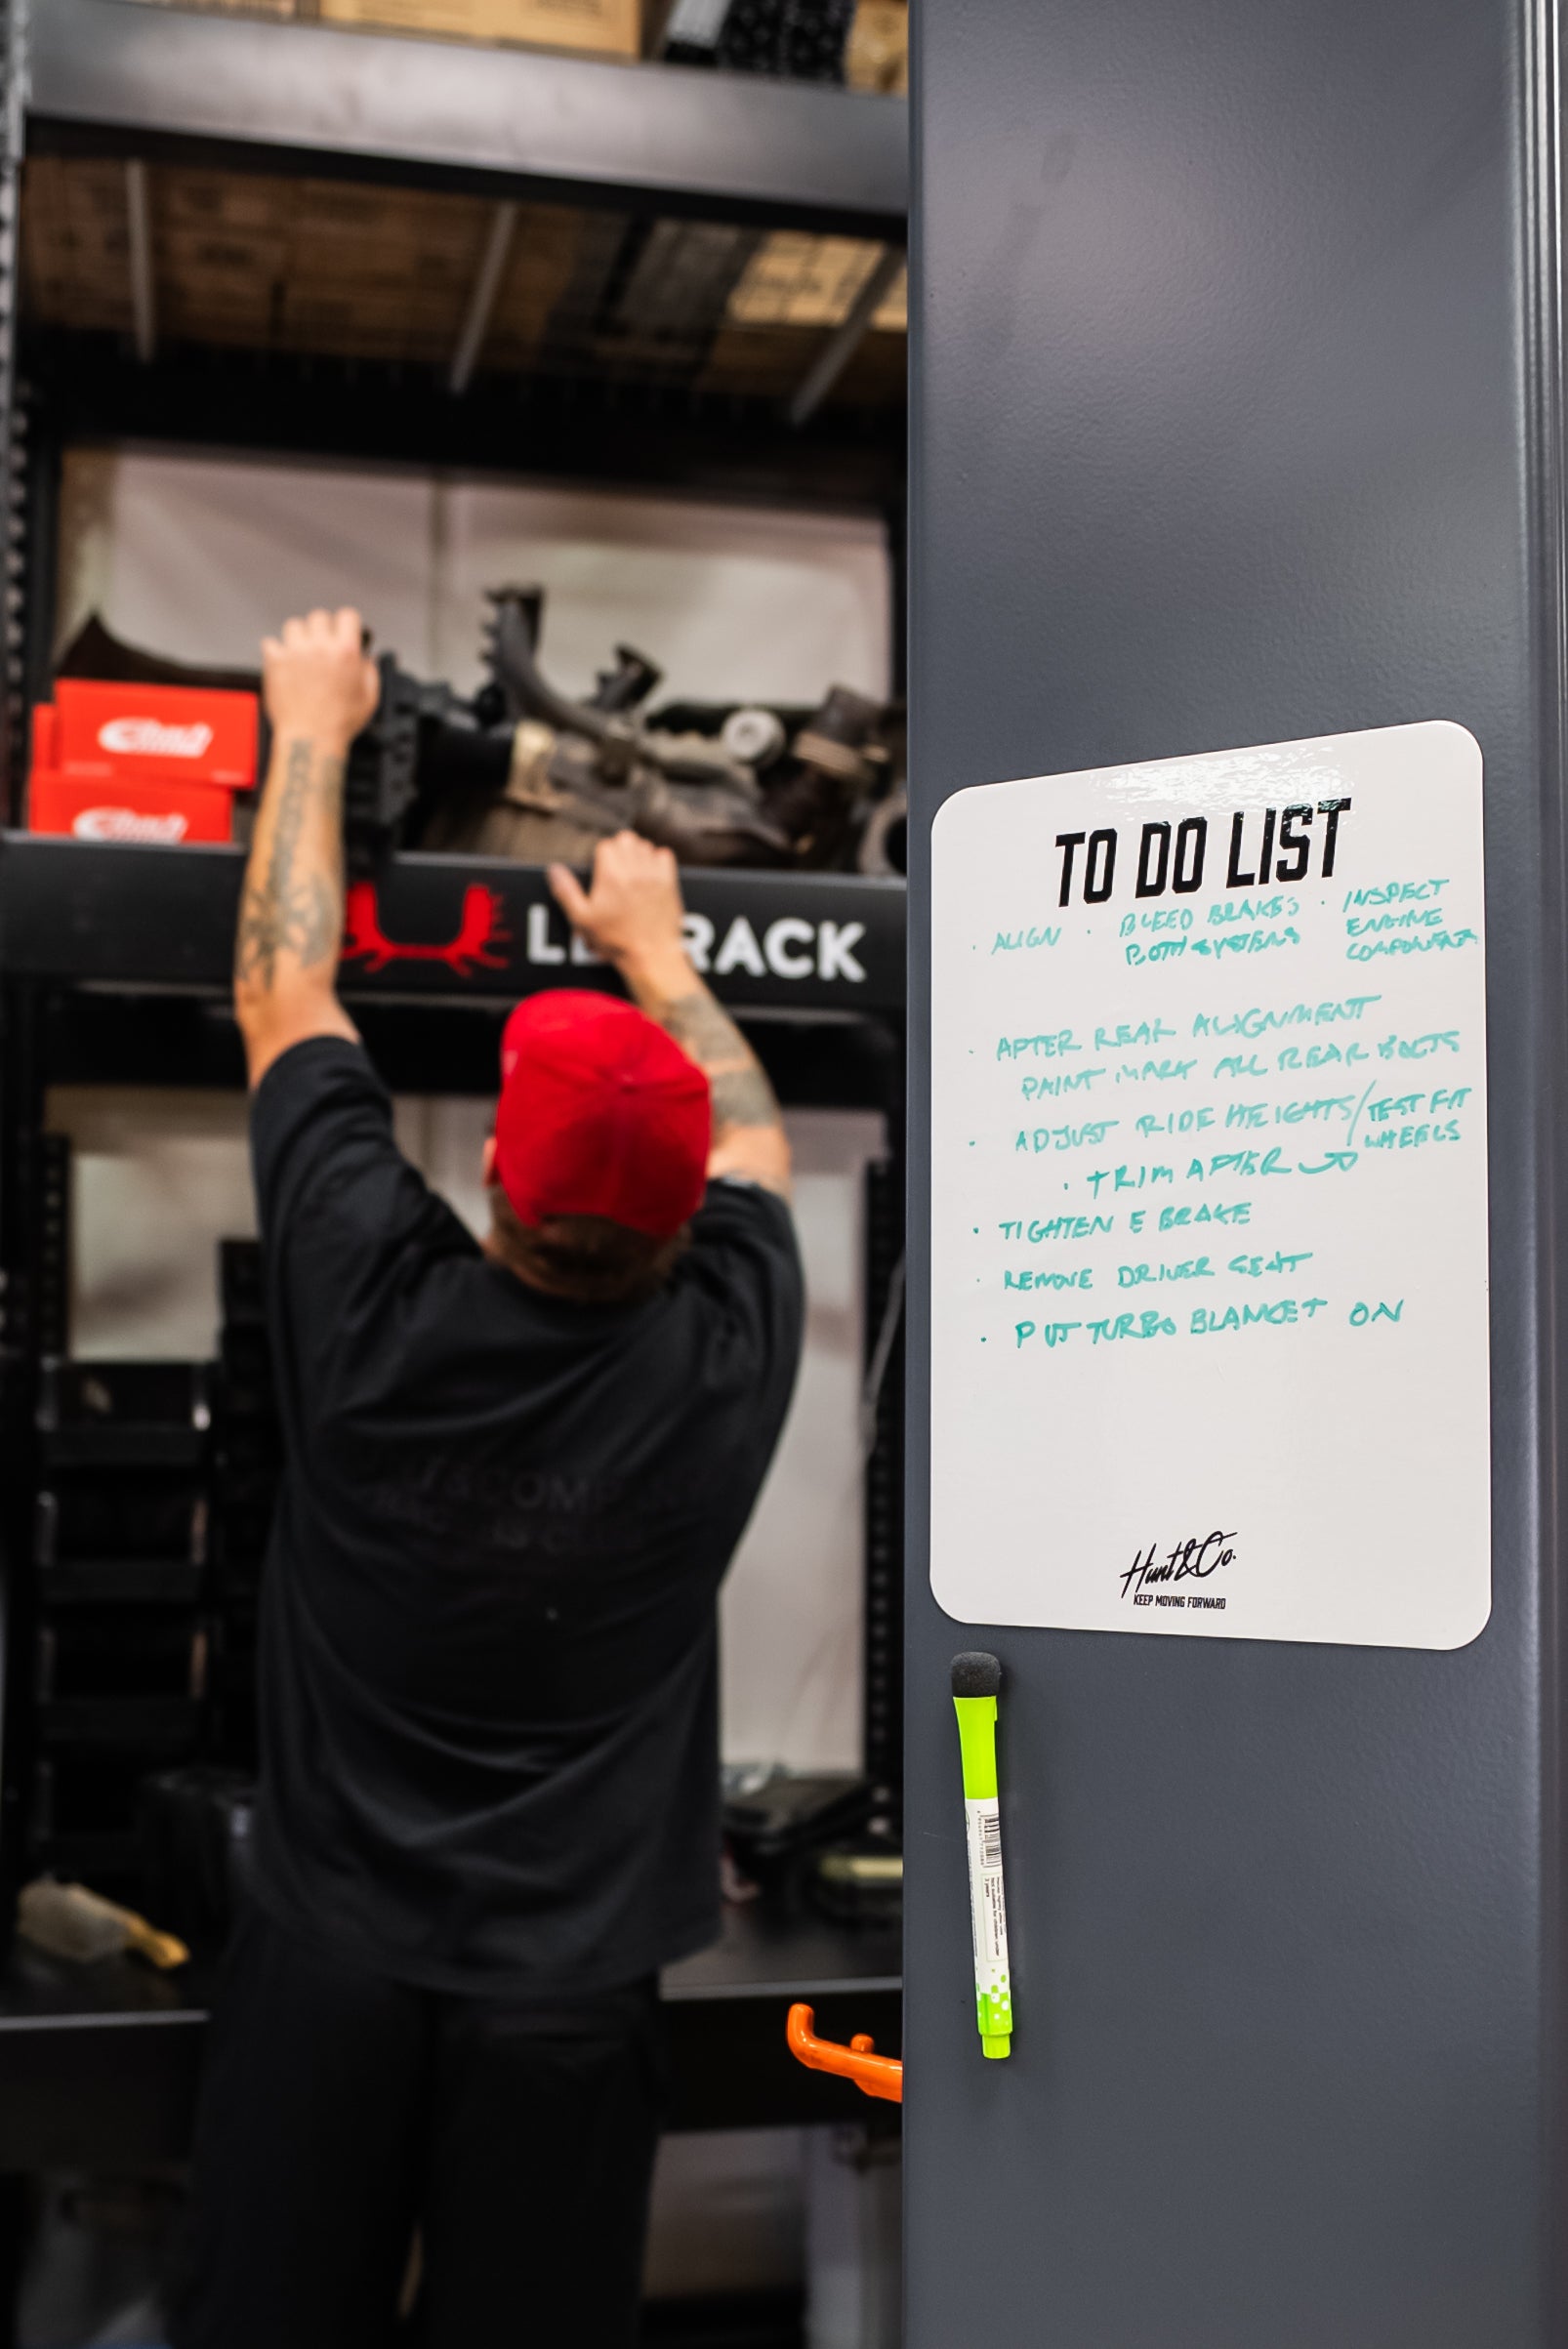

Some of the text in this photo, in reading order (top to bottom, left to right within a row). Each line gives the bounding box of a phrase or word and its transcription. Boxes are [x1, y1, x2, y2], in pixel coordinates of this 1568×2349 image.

[1055, 797, 1352, 907] TO DO LIST
[1342, 879, 1450, 913] INSPECT
[527, 904, 866, 982] LRACK
[991, 927, 1061, 956] ALIGN
[1119, 908, 1193, 937] BLEED
[1345, 908, 1443, 937] ENGINE
[997, 995, 1382, 1061] AFTER REAR ALIGNMENT
[1021, 1068, 1106, 1101] PAINT
[1116, 1059, 1198, 1084] MARK
[1213, 1053, 1268, 1079] ALL
[1277, 1043, 1370, 1071] REAR
[1015, 1120, 1120, 1153] ADJUST
[1135, 1107, 1217, 1138] RIDE
[1364, 1119, 1461, 1149] WHEELS
[1086, 1146, 1293, 1200] TRIM AFTER
[998, 1202, 1253, 1244] TIGHTEN E BRAKE
[1004, 1268, 1093, 1291] REMOVE
[1117, 1256, 1216, 1289] DRIVER
[1014, 1320, 1083, 1349] PUT
[1086, 1310, 1177, 1344] TURBO
[1348, 1298, 1405, 1327] ON
[1133, 1593, 1226, 1610] KEEP MOVING FORWARD
